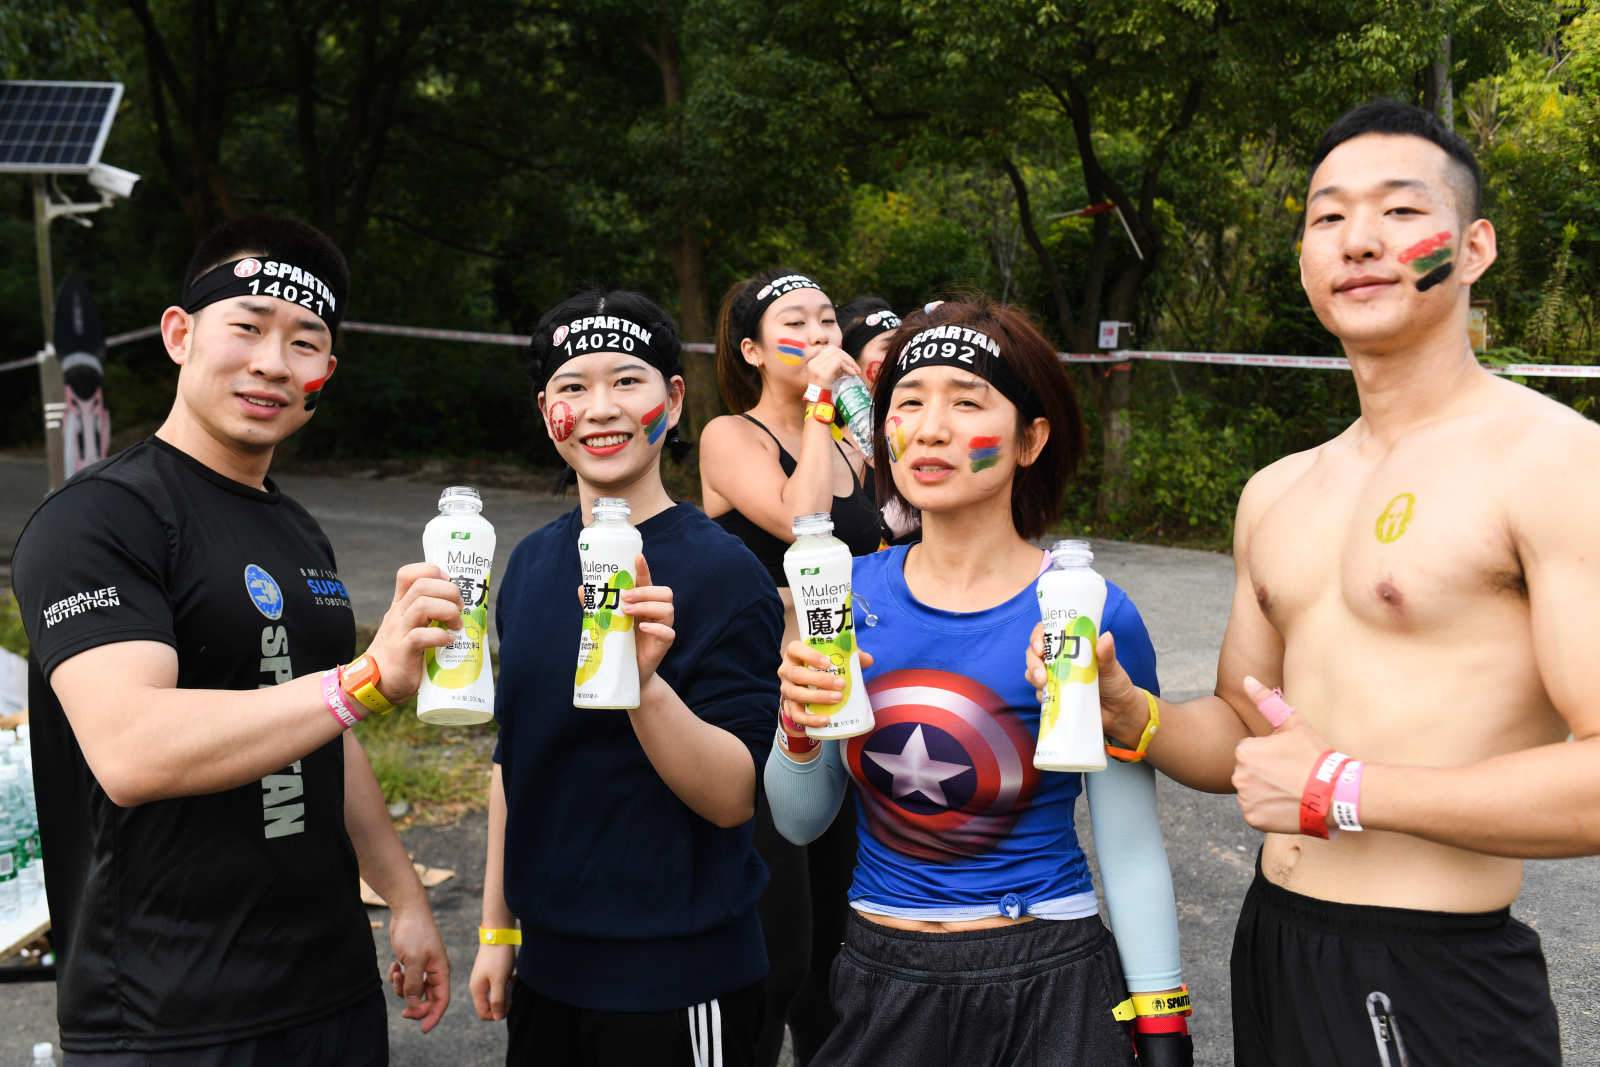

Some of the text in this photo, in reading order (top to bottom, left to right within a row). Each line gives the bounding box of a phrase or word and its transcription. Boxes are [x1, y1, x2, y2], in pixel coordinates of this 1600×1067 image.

[248, 279, 324, 316] 14021
[263, 261, 336, 312] SPARTAN
[564, 333, 634, 356] 14020
[570, 316, 652, 346] SPARTAN
[910, 325, 1000, 358] SPARTAN
[901, 343, 976, 370] 13092
[447, 565, 482, 575] Vitamin
[43, 586, 118, 619] HERBALIFE
[306, 578, 350, 599] SUPE
[803, 597, 838, 607] Vitamin
[46, 597, 120, 629] NUTRITION
[806, 603, 854, 635] 魔力
